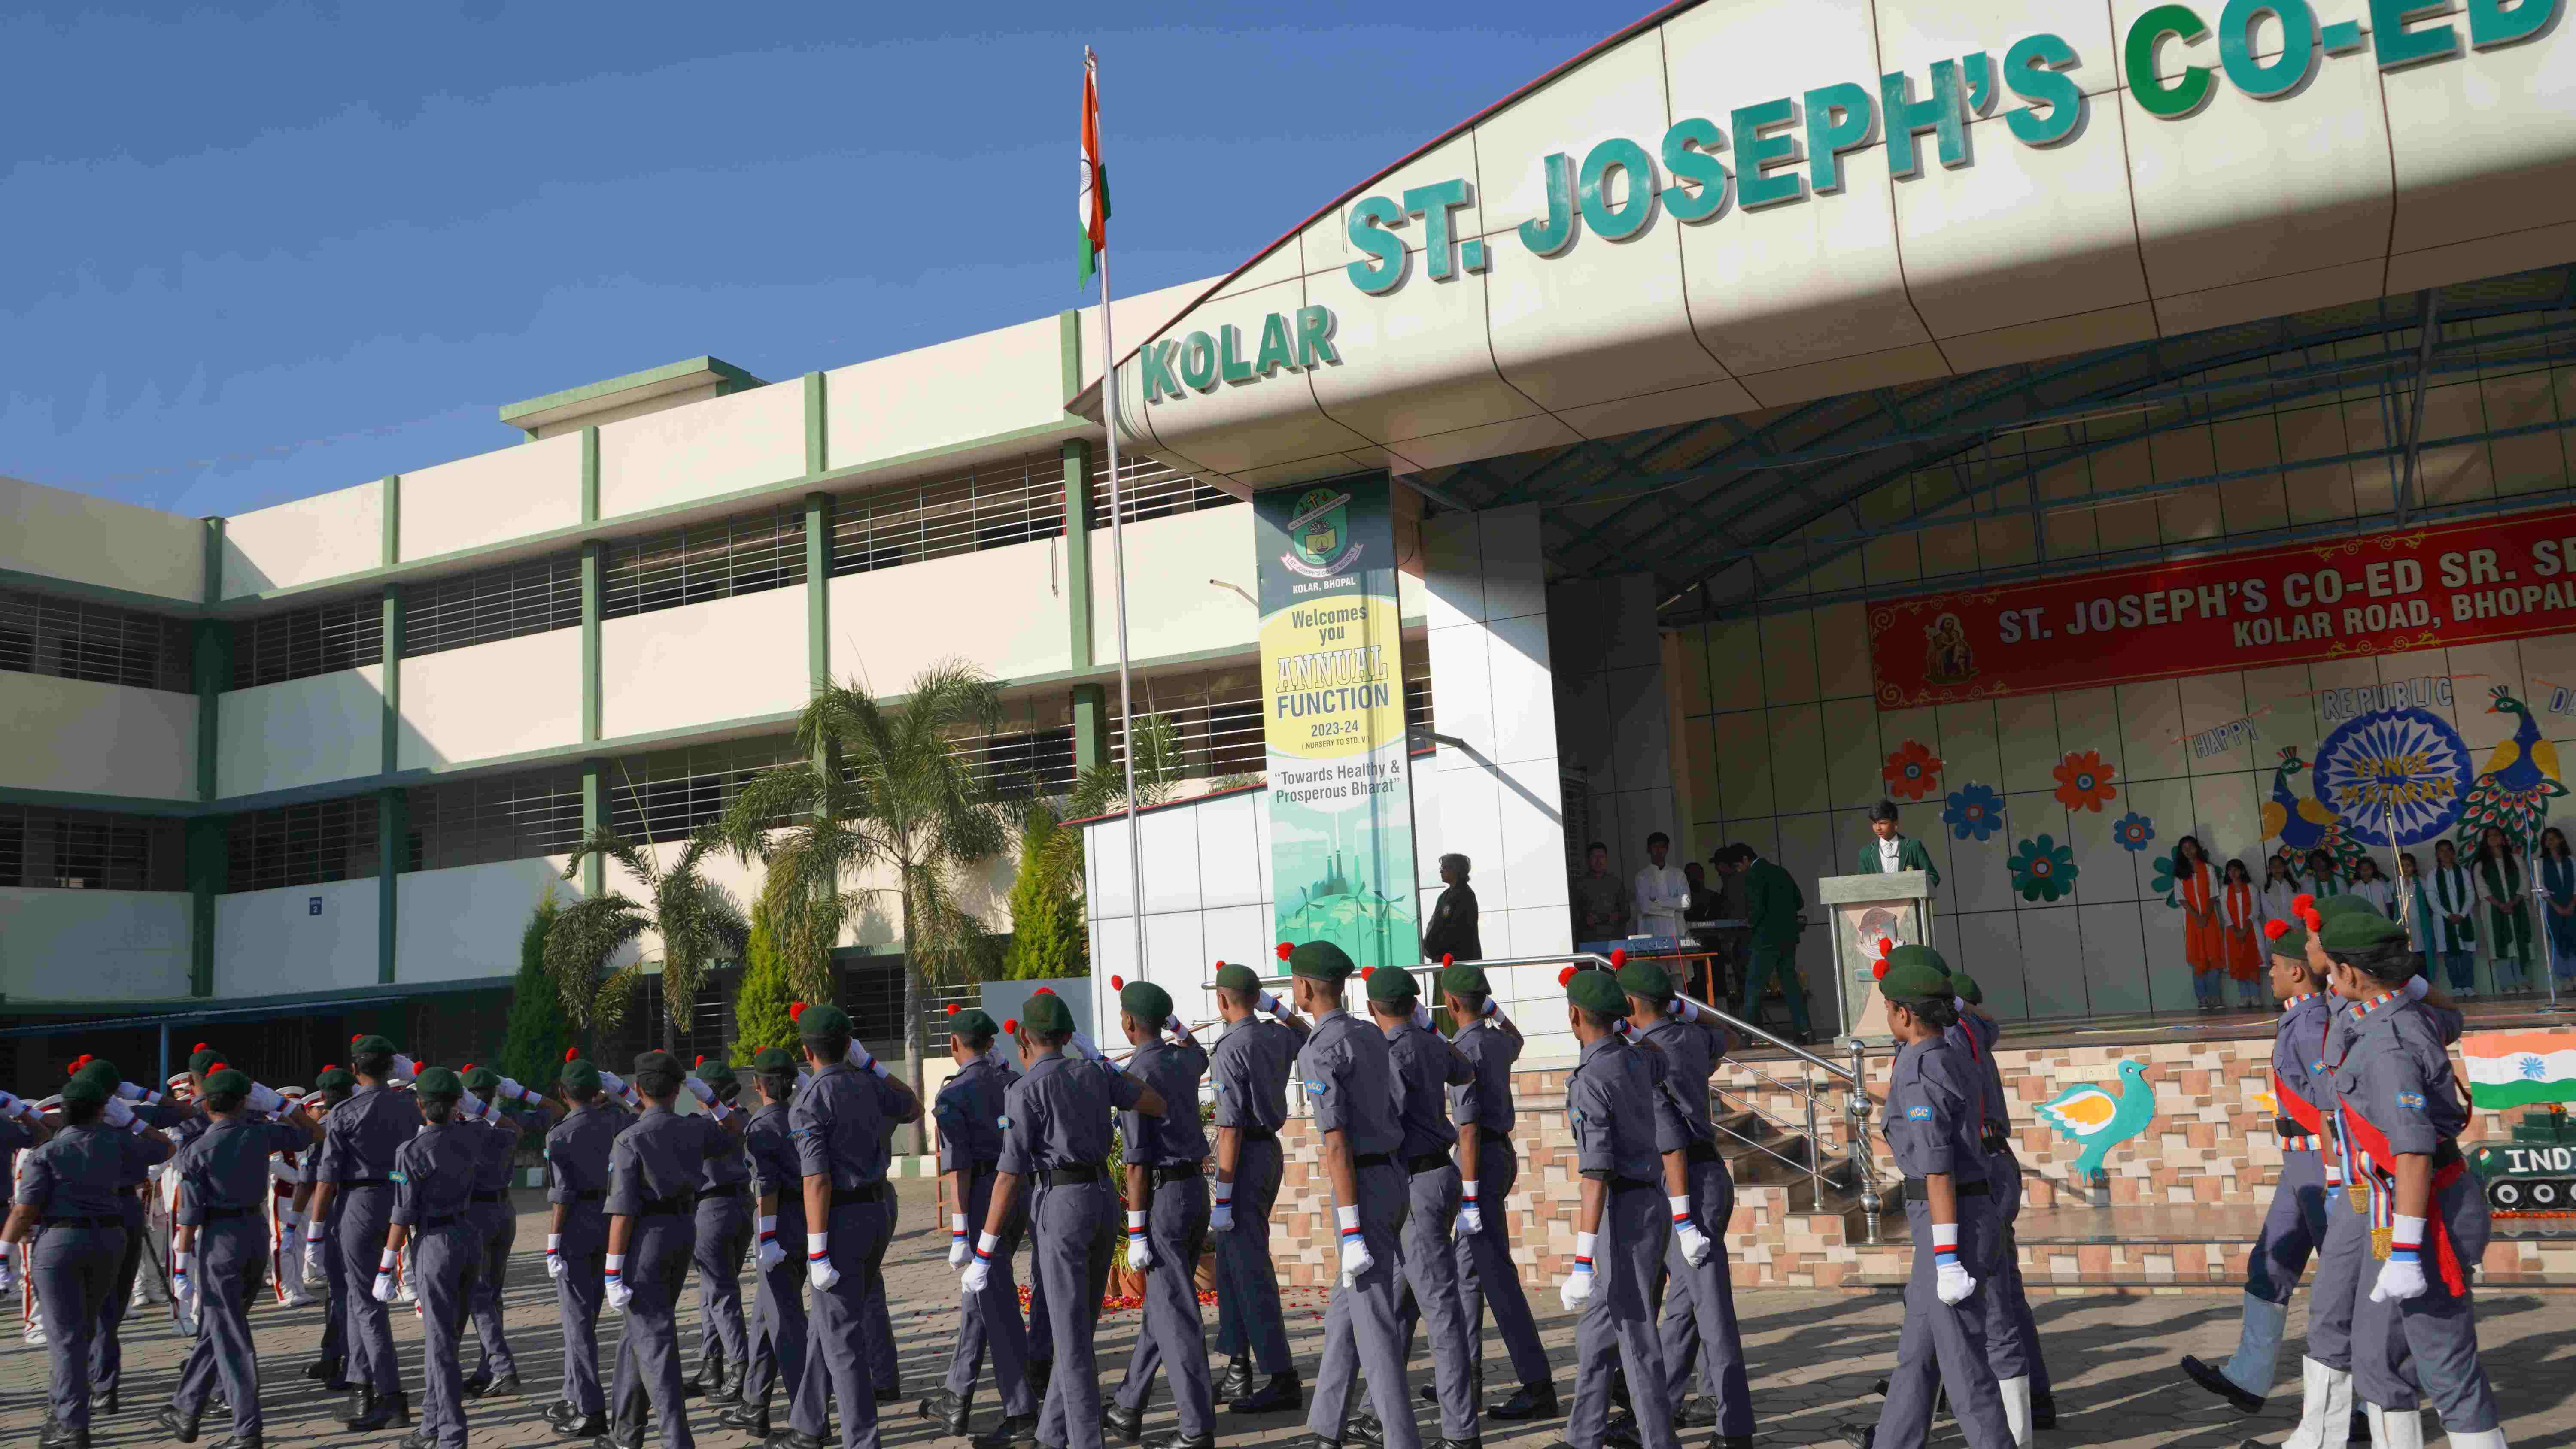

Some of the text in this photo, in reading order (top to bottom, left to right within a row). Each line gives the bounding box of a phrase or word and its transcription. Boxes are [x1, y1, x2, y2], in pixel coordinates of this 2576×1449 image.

[1346, 177, 1485, 295] ST.
[1518, 33, 2081, 256] JOSEPH'S
[1140, 304, 1340, 401] KOLAR
[1293, 576, 1356, 594] KOLAR, BHOPAL
[1999, 607, 2054, 643] ST.
[2066, 578, 2268, 635] JOSEPH'S
[2282, 558, 2423, 607] CO-ED
[2439, 549, 2517, 588] SR.
[1291, 606, 1367, 629] Welcomes
[2233, 580, 2576, 647] KOLAR ROAD, BHOPAL
[1319, 626, 1345, 646] you
[1276, 645, 1388, 693] ANNUAL
[1277, 682, 1389, 719] FUNCTION
[2322, 676, 2453, 720] REPUBLIC
[1311, 720, 1359, 737] 2023-24
[2192, 717, 2259, 758] HAPPY
[1306, 739, 1334, 749] NURSERY
[1346, 736, 1360, 744] STD.
[1337, 761, 1385, 779] Healthy
[1391, 759, 1400, 773] &
[2350, 752, 2433, 777] VANDE
[1276, 786, 1347, 804] Prosperous
[2341, 776, 2456, 804] MATARAM
[1306, 1082, 1322, 1091] NCC
[1909, 1108, 1928, 1118] NCC
[2505, 1147, 2576, 1173] IND
